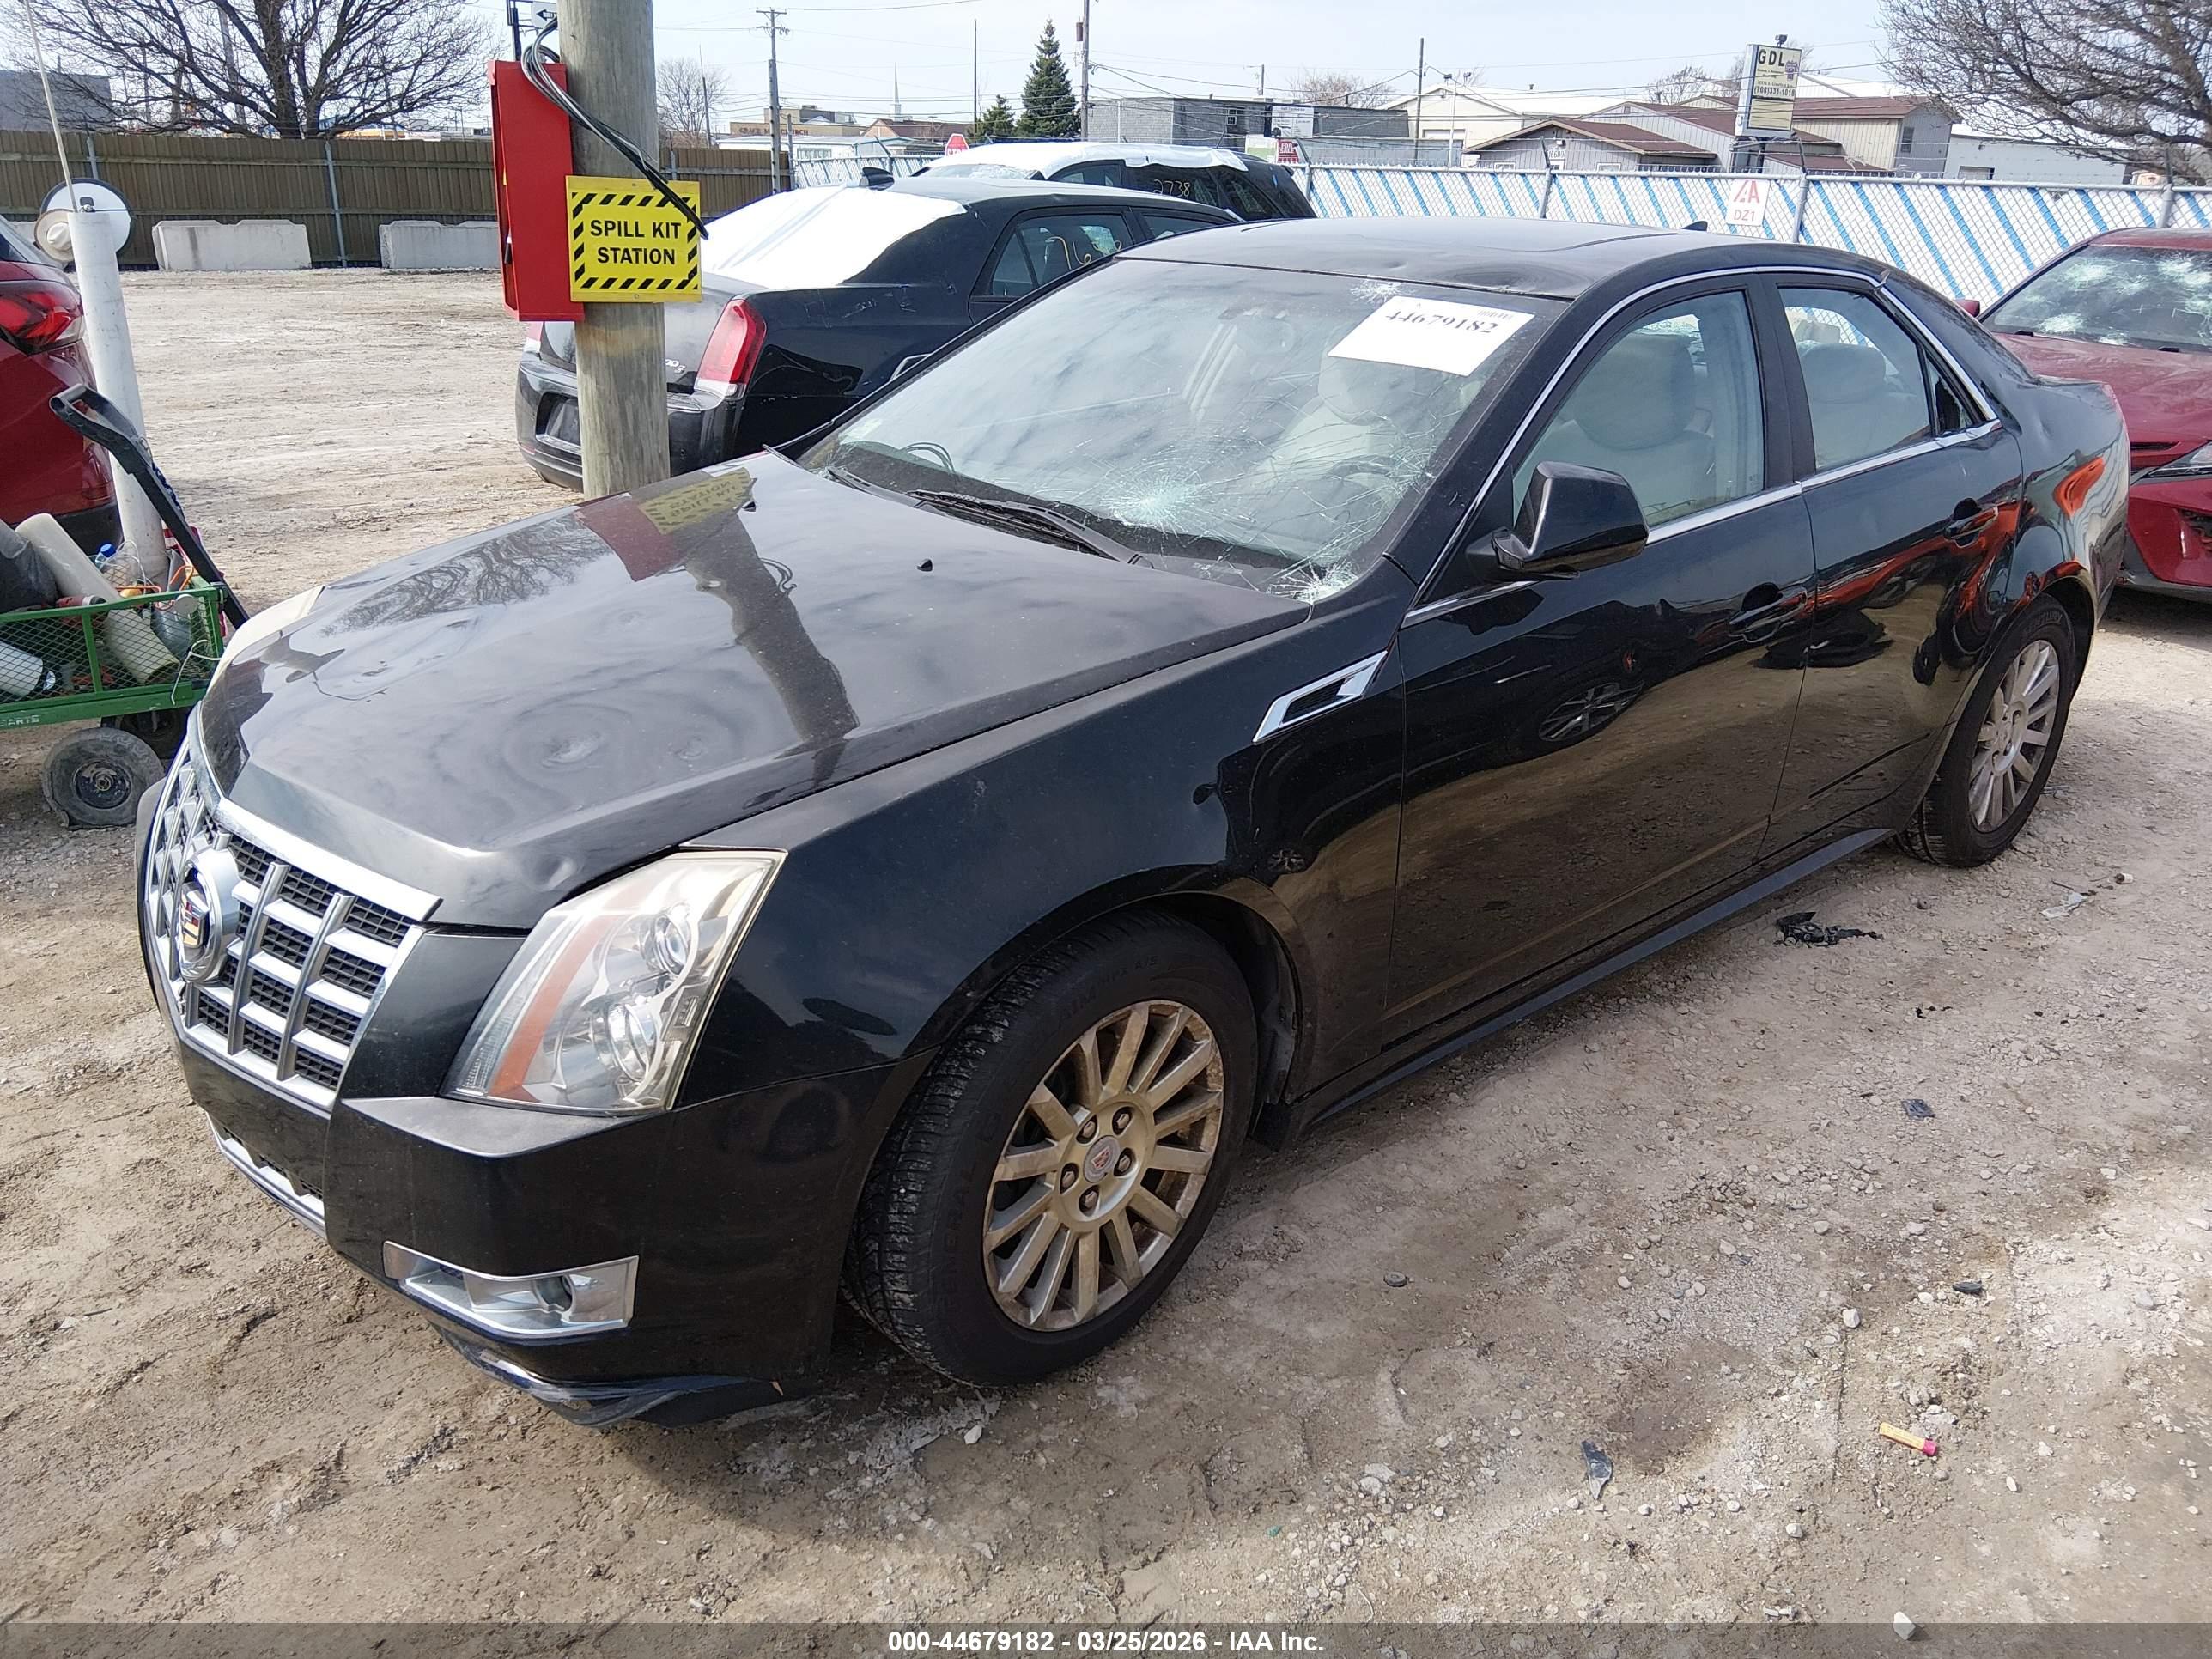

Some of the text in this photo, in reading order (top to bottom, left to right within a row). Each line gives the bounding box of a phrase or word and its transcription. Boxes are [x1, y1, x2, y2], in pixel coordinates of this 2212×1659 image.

[1758, 49, 1785, 67] GDL
[1152, 179, 1191, 198] 2738
[590, 219, 681, 239] SPILL KIT
[597, 246, 676, 265] STATION
[1385, 310, 1498, 334] 44679182
